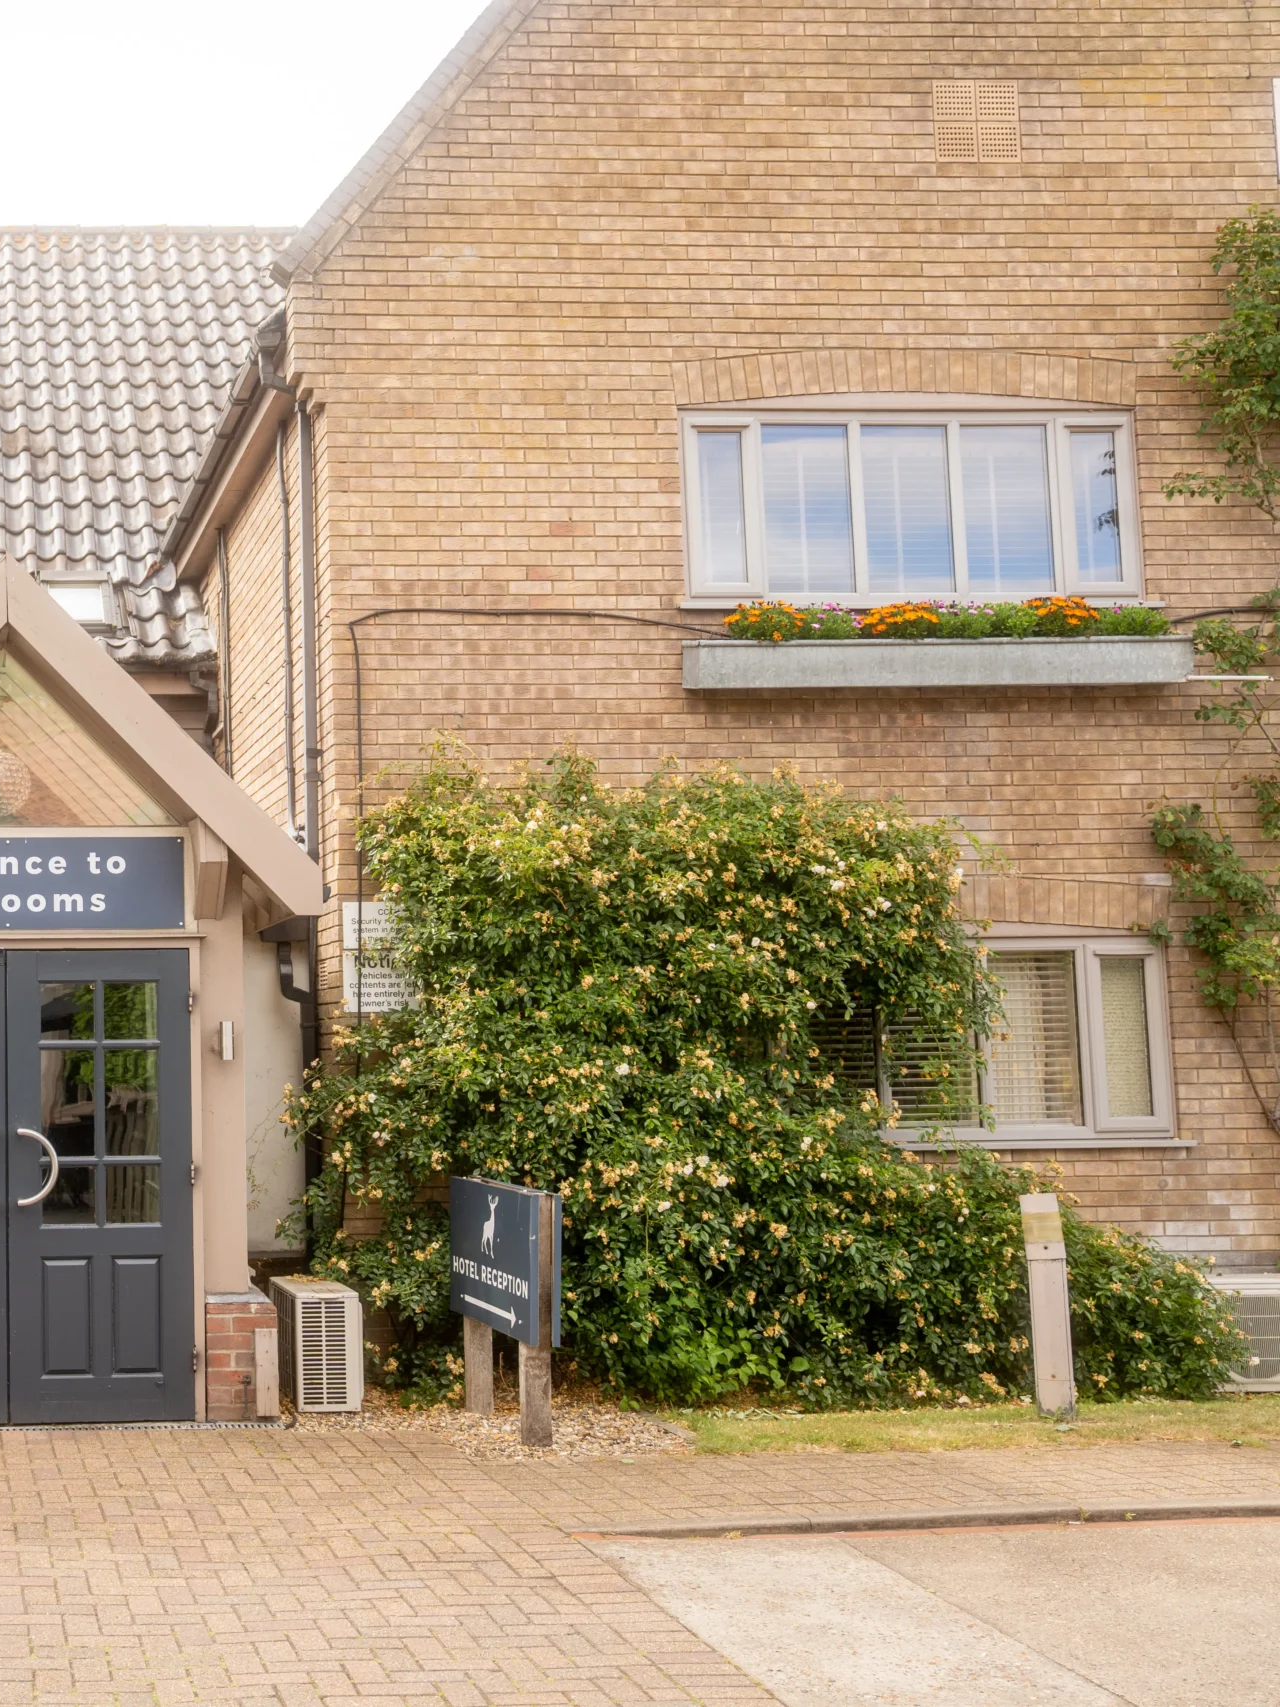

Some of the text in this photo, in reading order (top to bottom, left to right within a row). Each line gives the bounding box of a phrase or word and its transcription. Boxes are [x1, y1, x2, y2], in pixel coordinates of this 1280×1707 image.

[87, 851, 126, 875] to
[349, 981, 388, 989] contents
[374, 990, 405, 999] entirely
[453, 1255, 529, 1300] HOTEL RECEPTION
